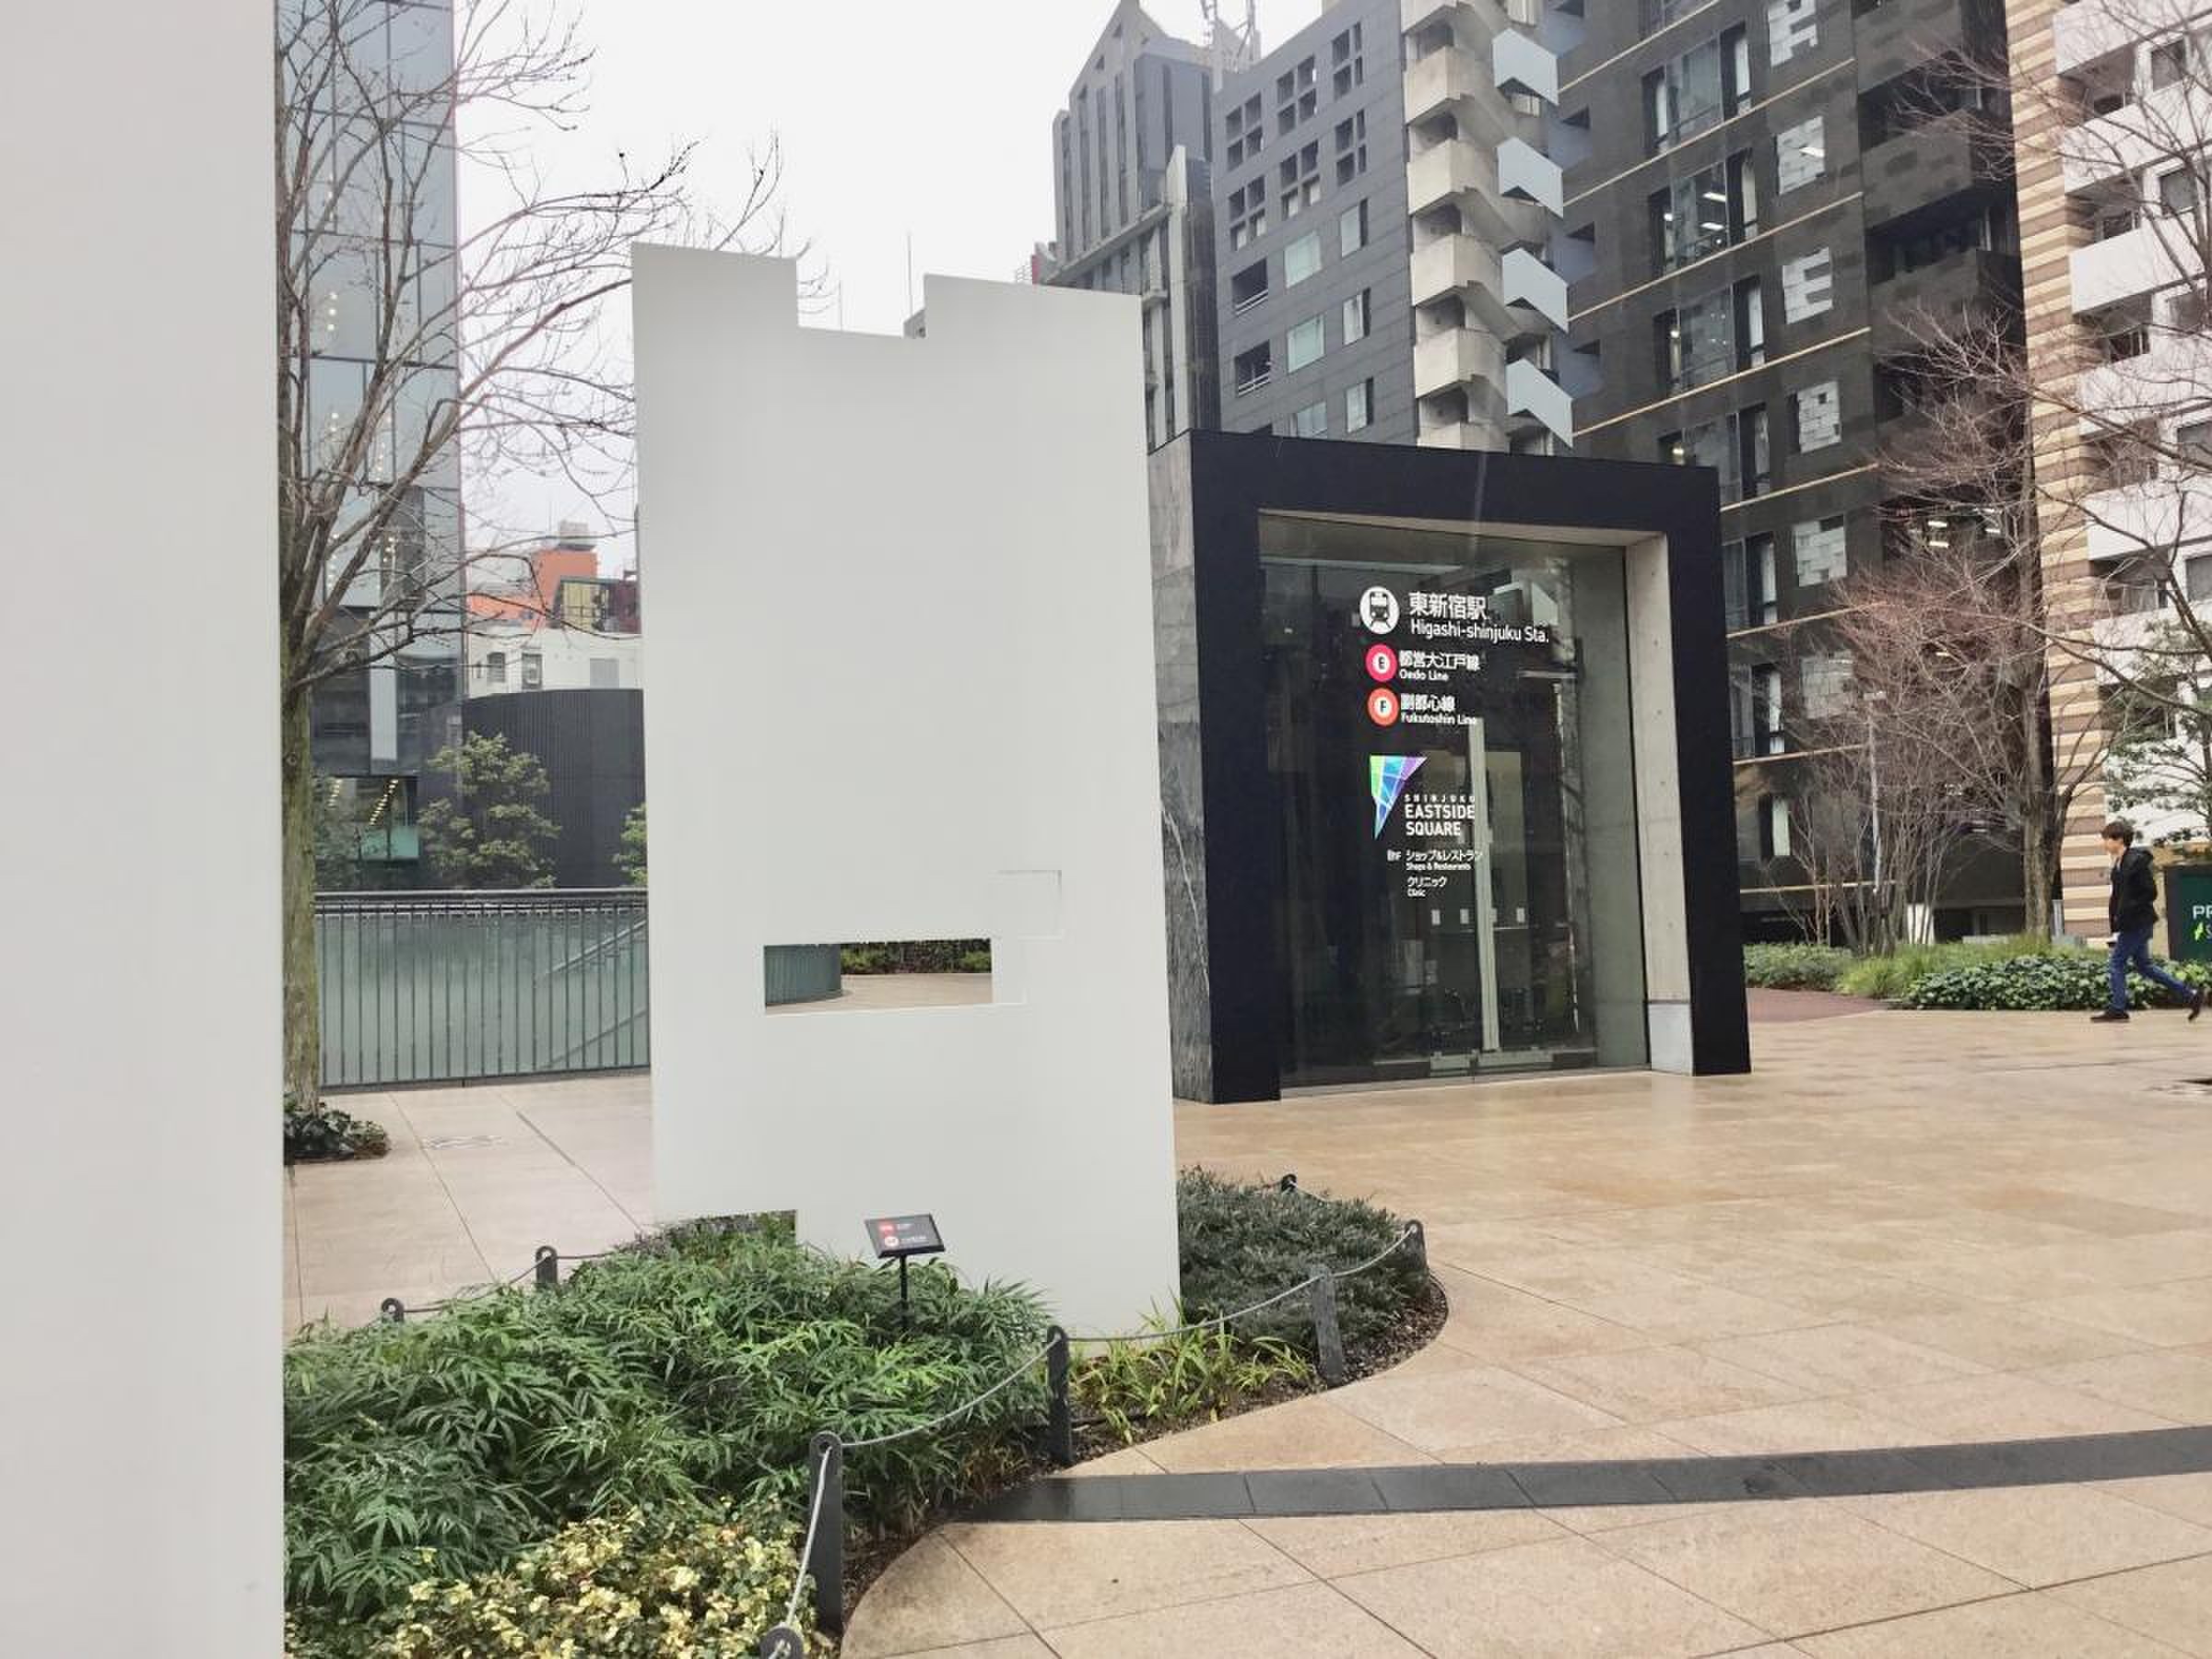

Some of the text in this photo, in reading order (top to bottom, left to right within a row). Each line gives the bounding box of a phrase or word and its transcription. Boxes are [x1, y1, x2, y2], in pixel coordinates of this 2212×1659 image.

[1408, 592, 1489, 620] 東新宿駅
[1411, 619, 1549, 643] Higashi-shinjuku Sta.
[1429, 670, 1450, 681] Line
[1457, 714, 1477, 726] Line
[1406, 805, 1475, 819] EASTSIDE
[1405, 821, 1462, 836] SQUARE
[1407, 877, 1447, 887] クリニック
